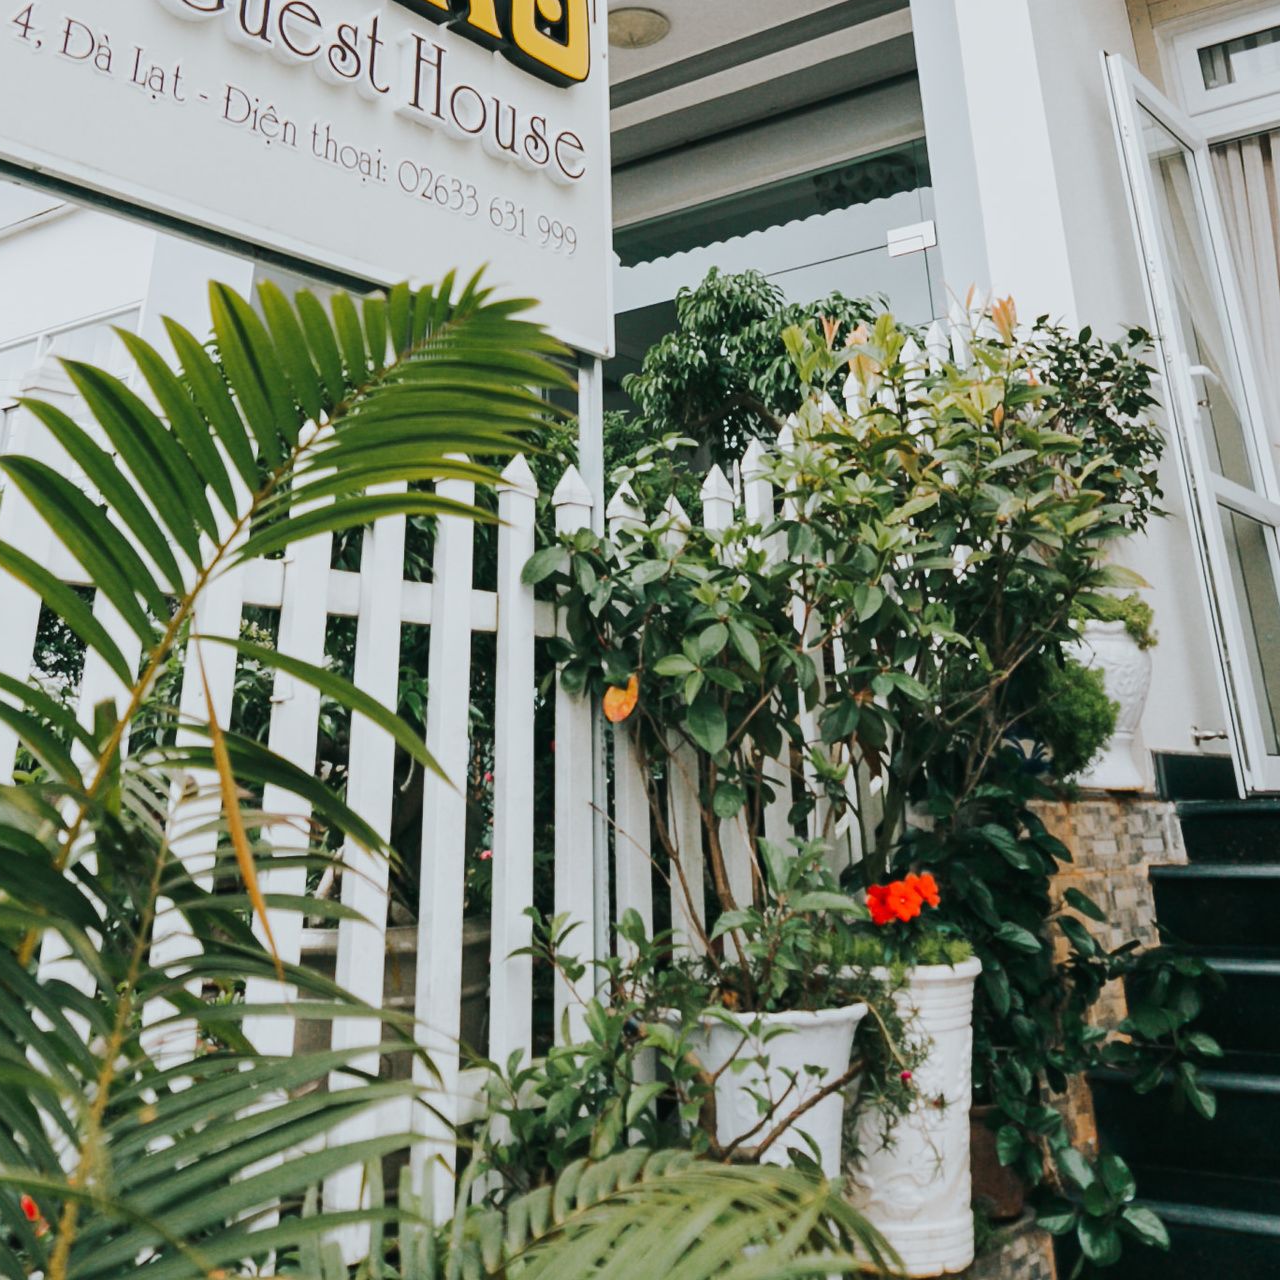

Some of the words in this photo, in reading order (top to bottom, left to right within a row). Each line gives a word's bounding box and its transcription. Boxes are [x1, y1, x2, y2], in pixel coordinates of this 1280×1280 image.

[11, 1, 43, 49] 4,
[59, 17, 113, 74] Đà
[130, 45, 186, 100] Lạt
[221, 84, 298, 145] Điện
[310, 122, 388, 183] thoại:
[397, 159, 480, 217] 02633
[488, 196, 528, 239] 631
[537, 214, 578, 256] 999
[407, 32, 588, 180] House
